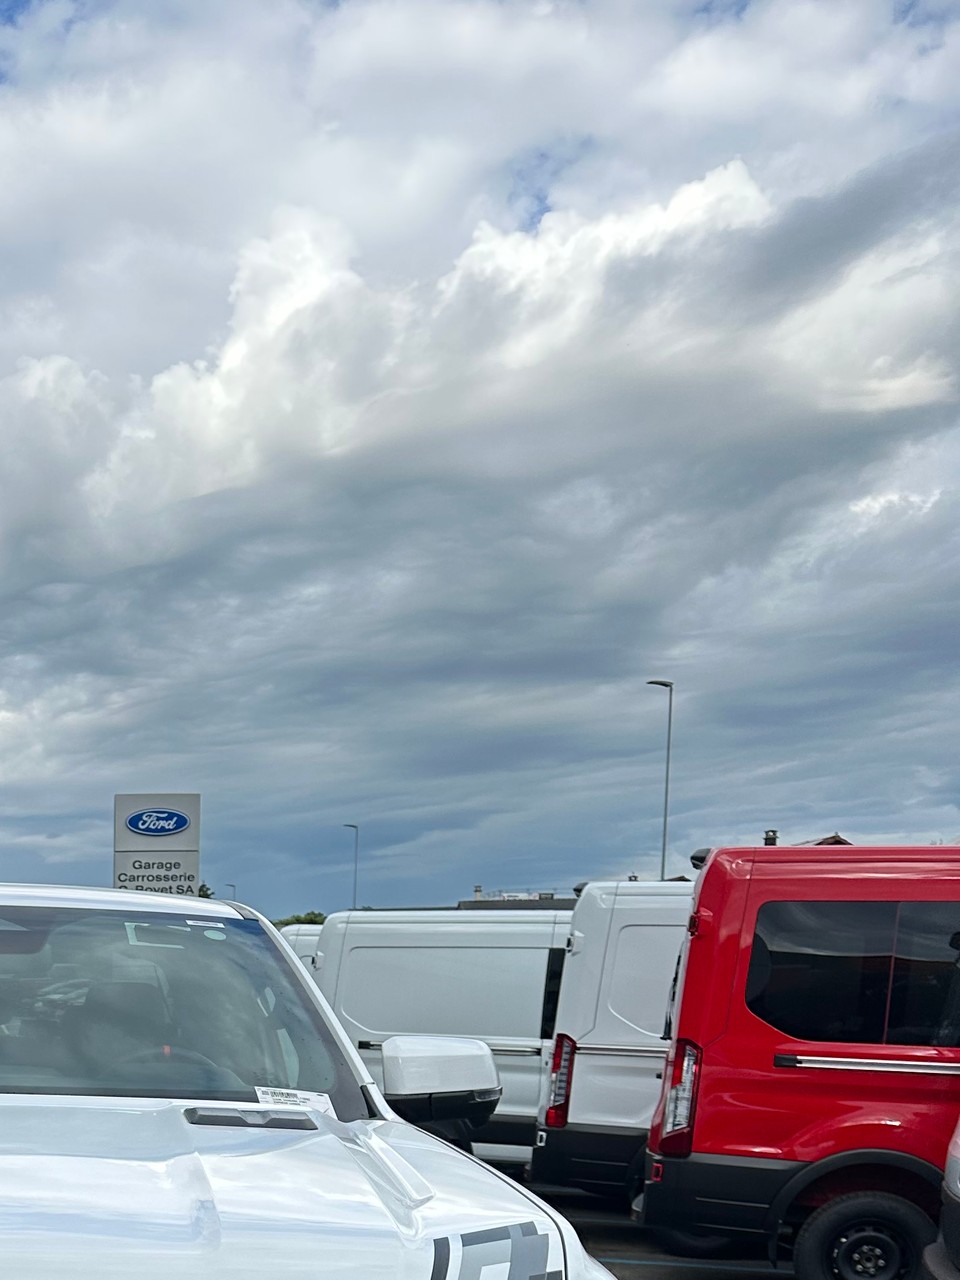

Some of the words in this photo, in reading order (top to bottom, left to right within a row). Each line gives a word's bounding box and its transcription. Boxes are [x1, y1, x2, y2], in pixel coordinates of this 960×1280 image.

[138, 812, 178, 830] Ford
[132, 860, 181, 871] Garage
[117, 872, 196, 883] Carrosserie
[176, 884, 194, 894] SA
